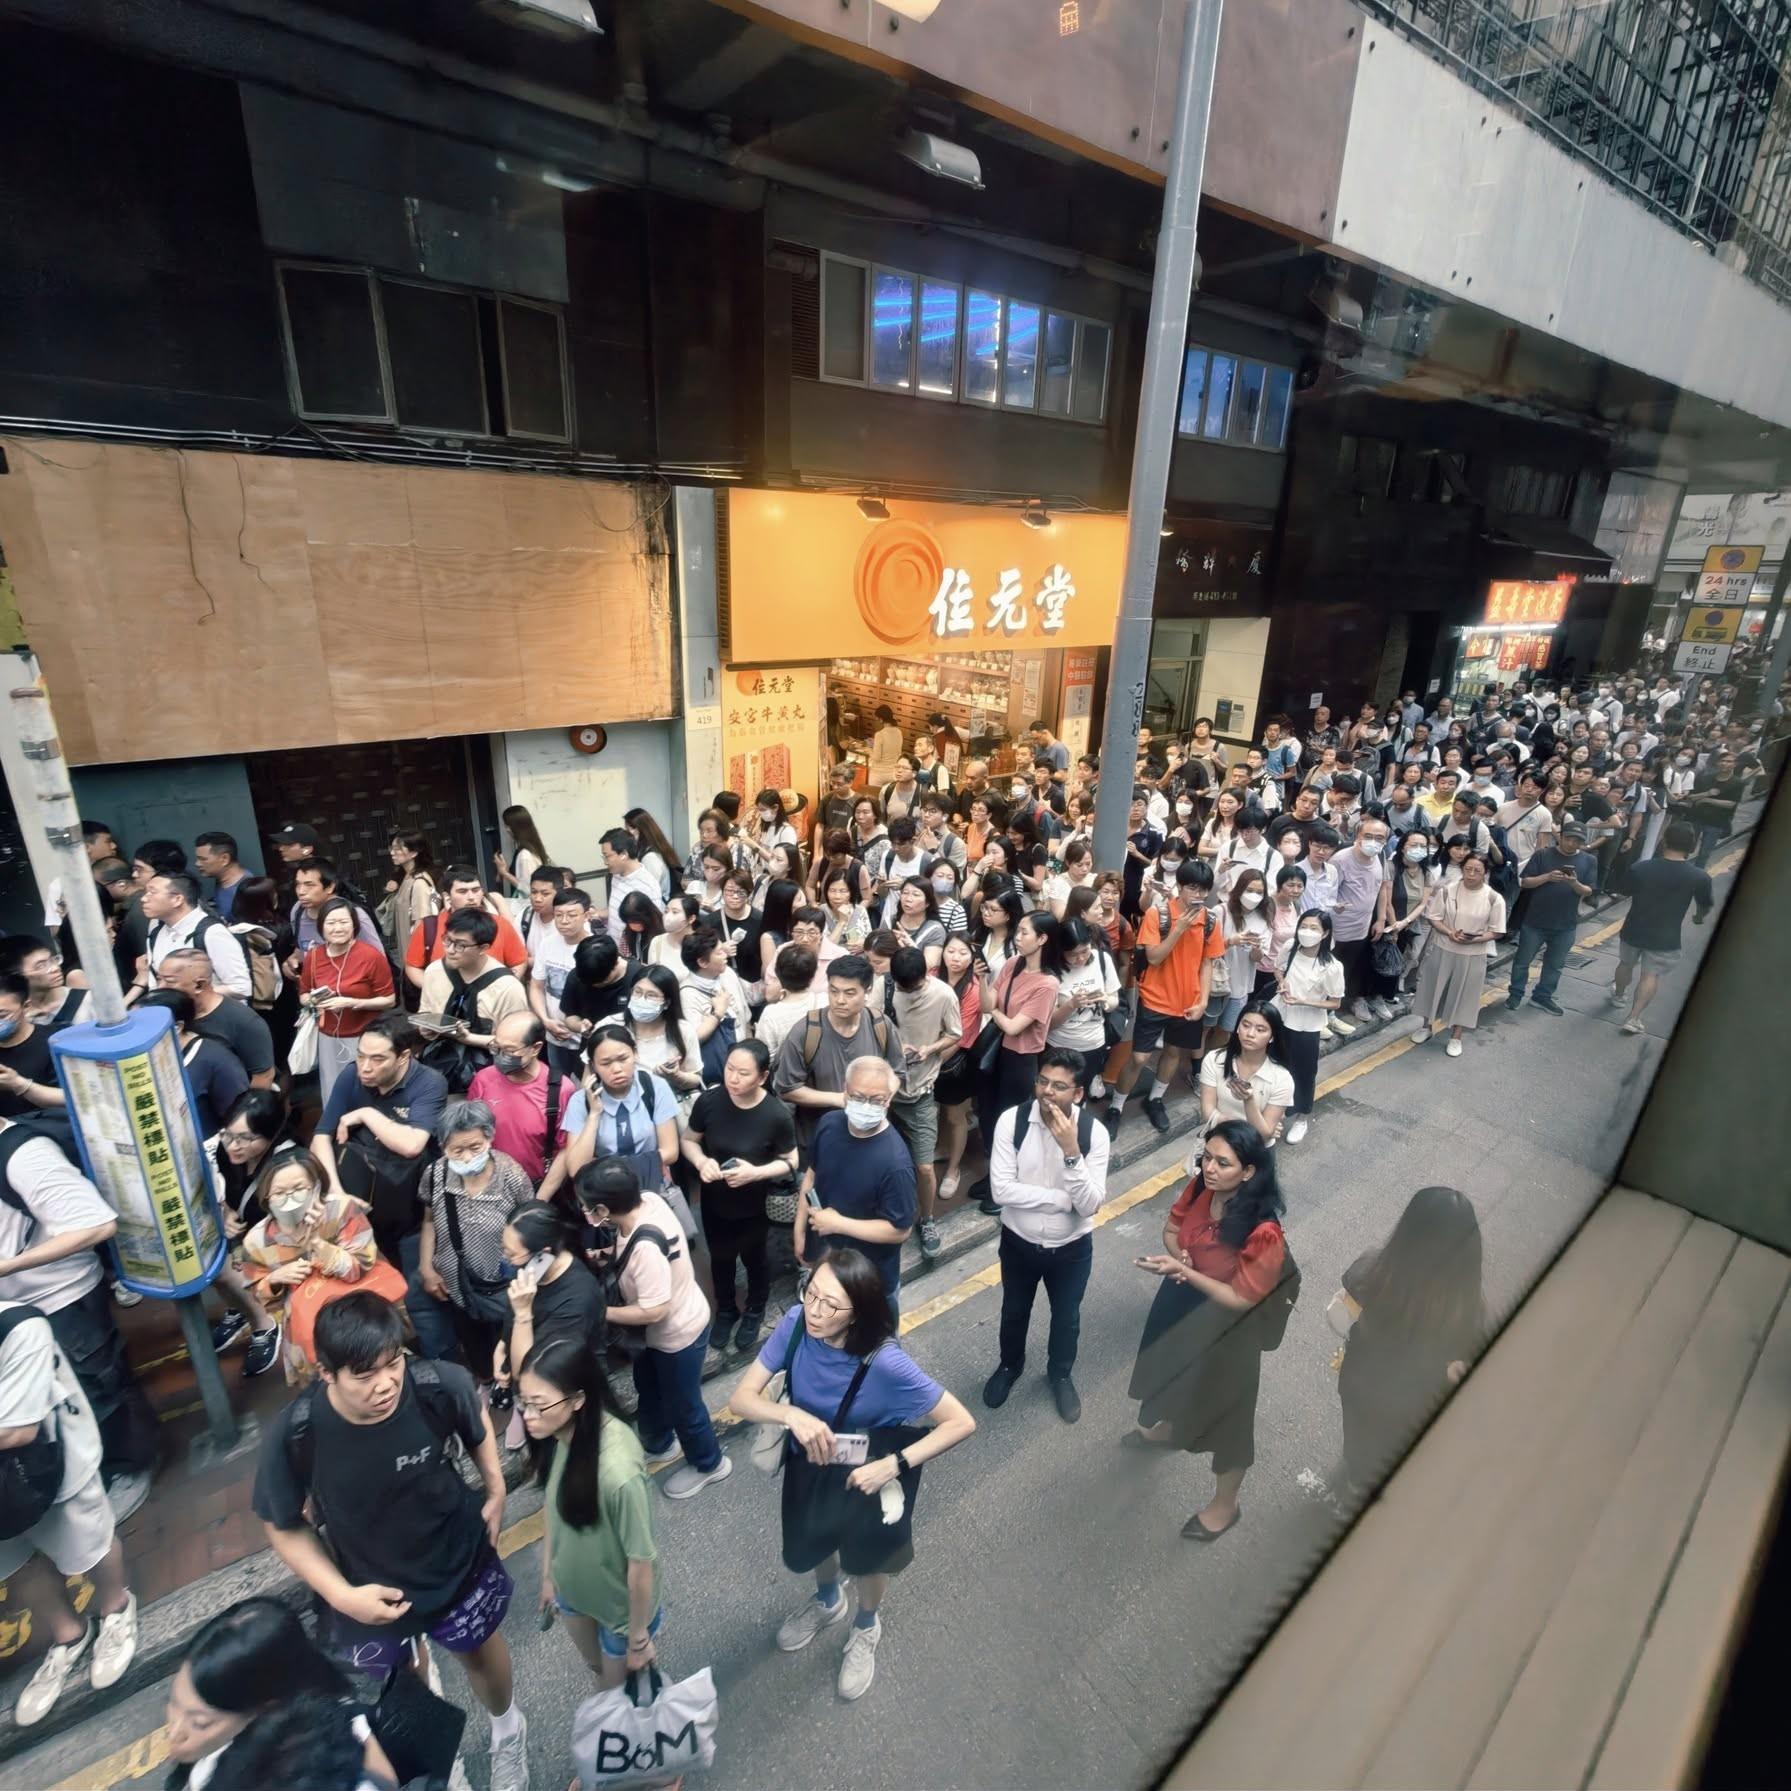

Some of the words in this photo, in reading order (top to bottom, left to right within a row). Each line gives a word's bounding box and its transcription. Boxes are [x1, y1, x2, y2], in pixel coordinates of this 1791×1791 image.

[1705, 576, 1723, 586] 24
[1726, 576, 1748, 586] hrs
[929, 562, 1077, 637] 位元堂
[1704, 588, 1740, 601] 全日
[1693, 646, 1718, 656] End
[1684, 656, 1717, 670] 終止
[752, 674, 796, 696] 位元堂
[696, 716, 713, 725] 419
